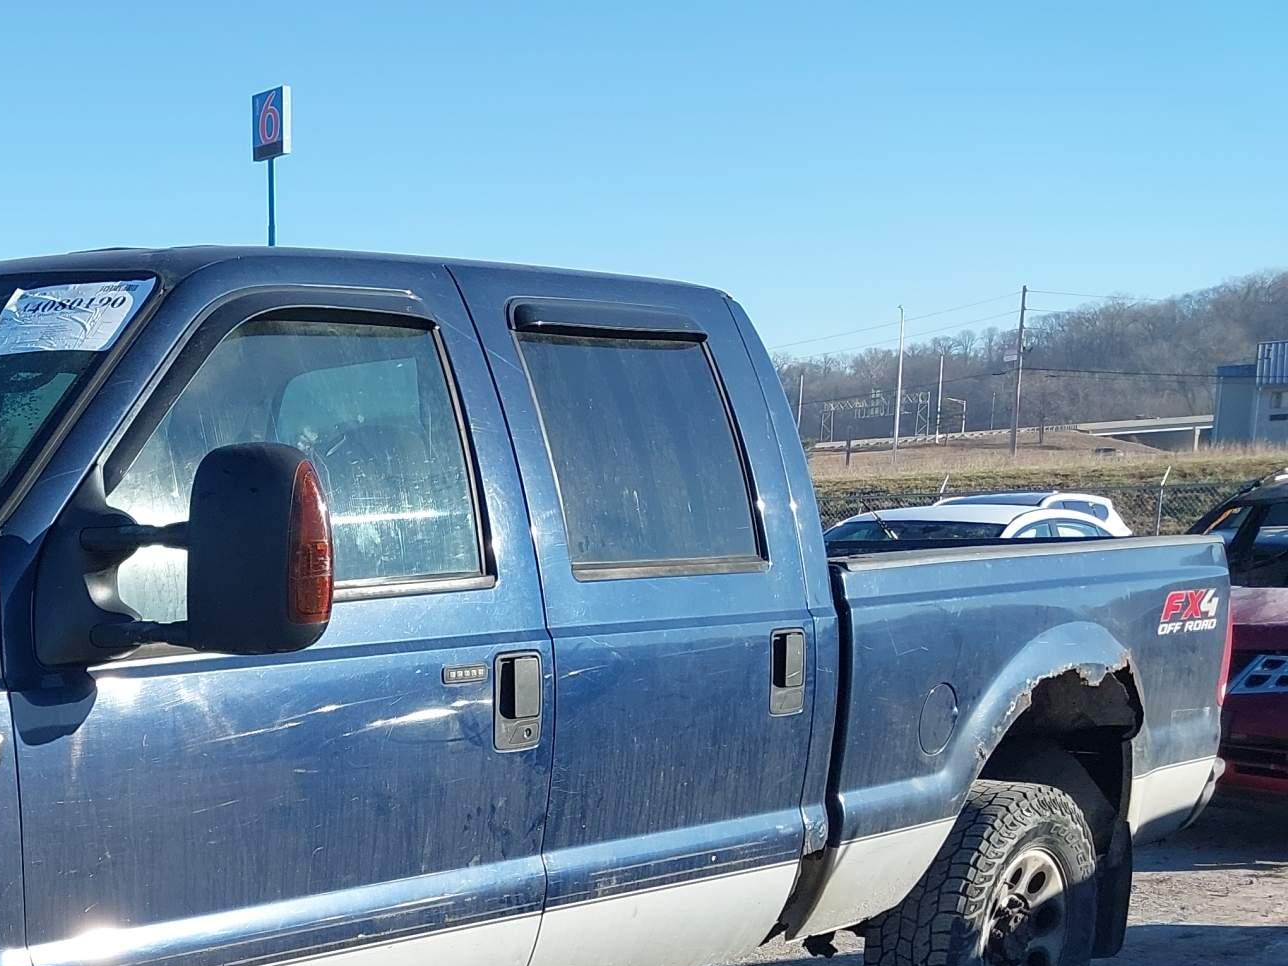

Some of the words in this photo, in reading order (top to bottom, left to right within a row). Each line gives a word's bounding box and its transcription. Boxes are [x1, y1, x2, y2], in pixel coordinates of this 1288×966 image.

[259, 91, 280, 144] 6
[1160, 587, 1220, 623] FX4
[1157, 622, 1183, 636] OFF
[1184, 618, 1217, 633] ROAD
